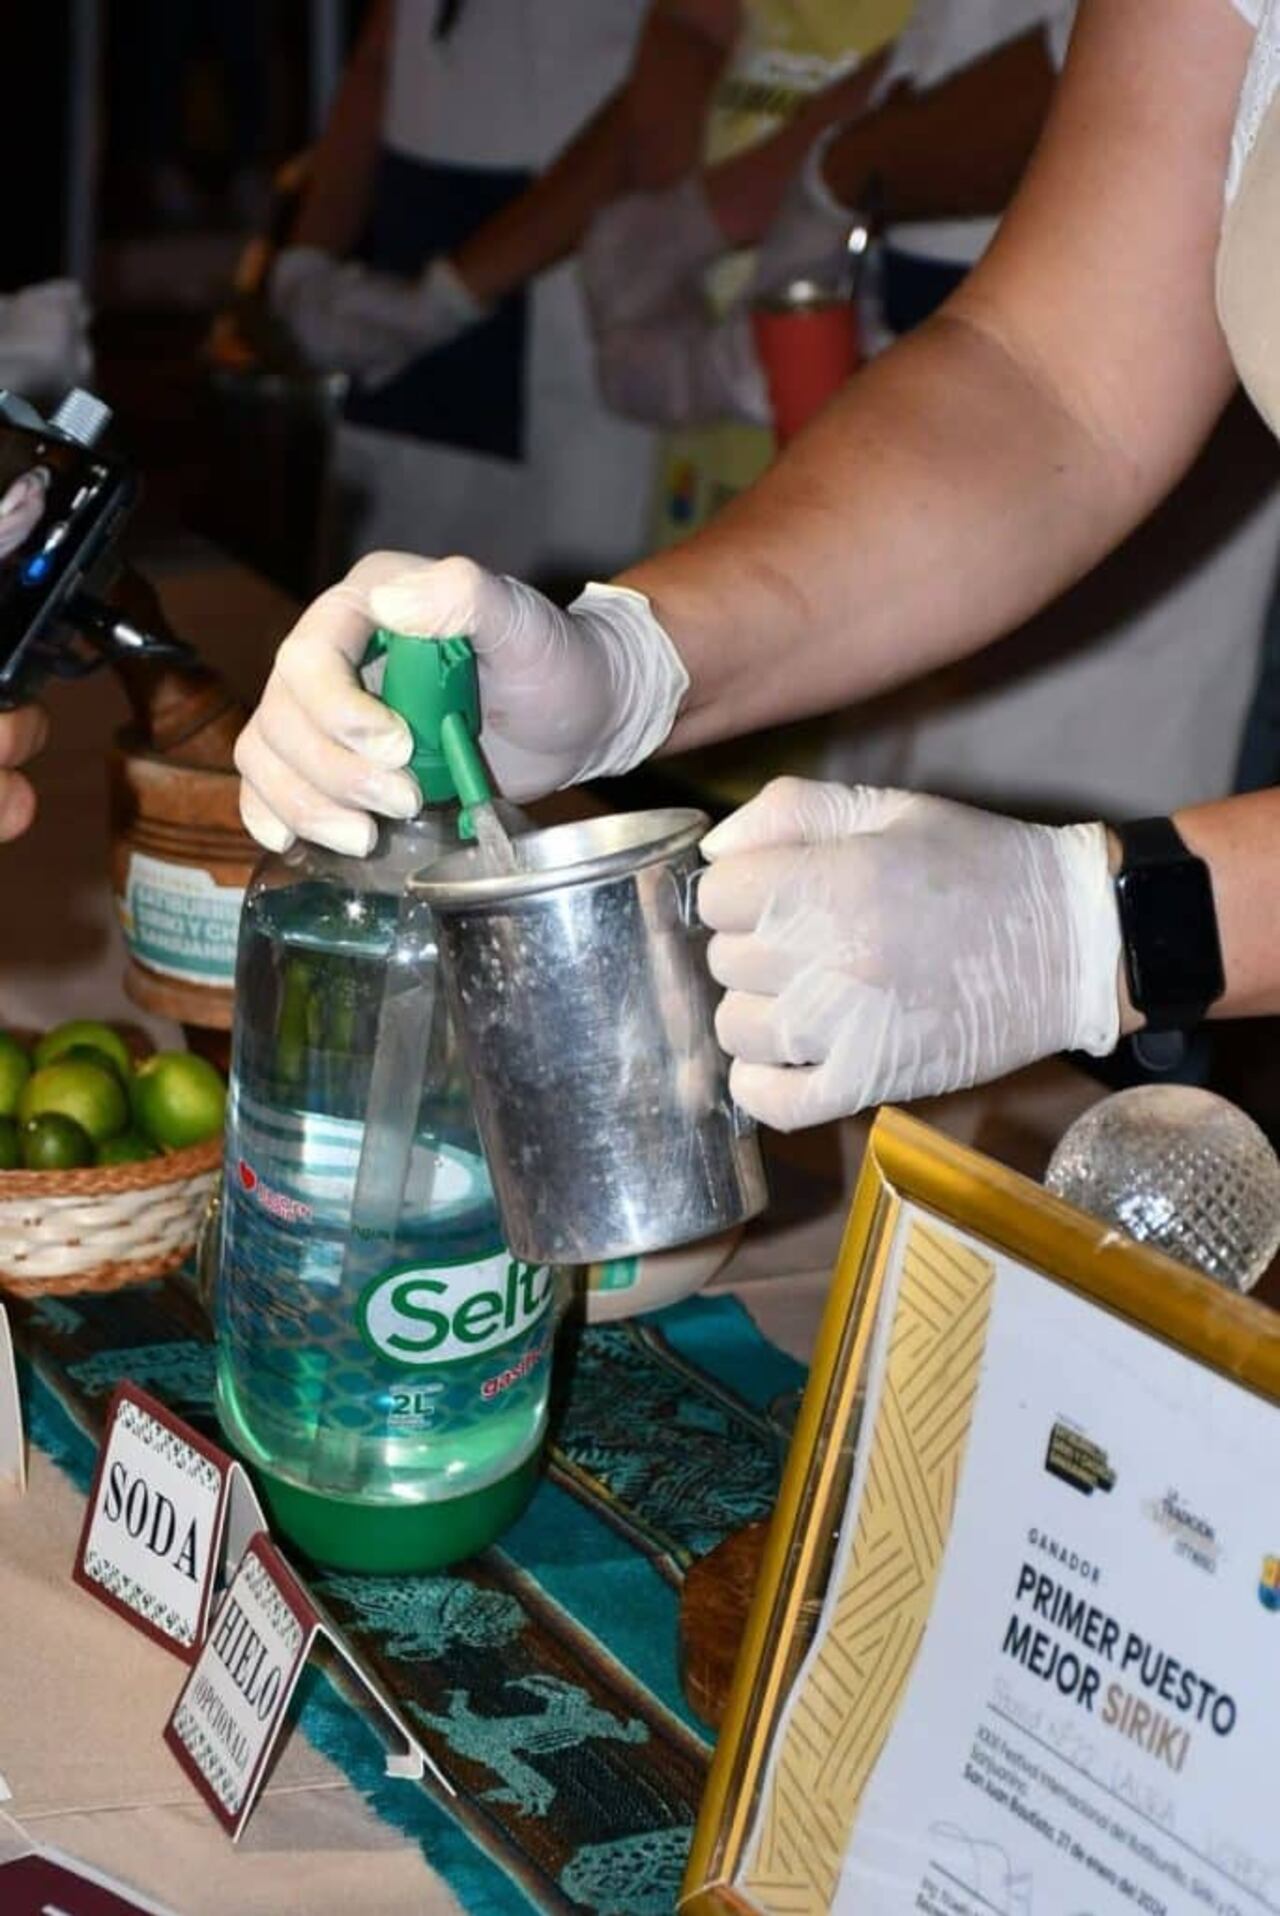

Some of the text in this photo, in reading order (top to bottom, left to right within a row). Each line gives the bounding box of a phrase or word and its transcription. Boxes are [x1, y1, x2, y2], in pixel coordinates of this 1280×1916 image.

[392, 1393, 433, 1415] 2L
[103, 1461, 198, 1582] SODA
[1027, 1528, 1101, 1583] GANADOR
[213, 1598, 281, 1721] HIELO
[1002, 1614, 1102, 1712] MEJOR
[1102, 1682, 1191, 1773] SIRIKI
[1015, 1562, 1120, 1662] PRIMER
[1121, 1633, 1236, 1736] PUESTO
